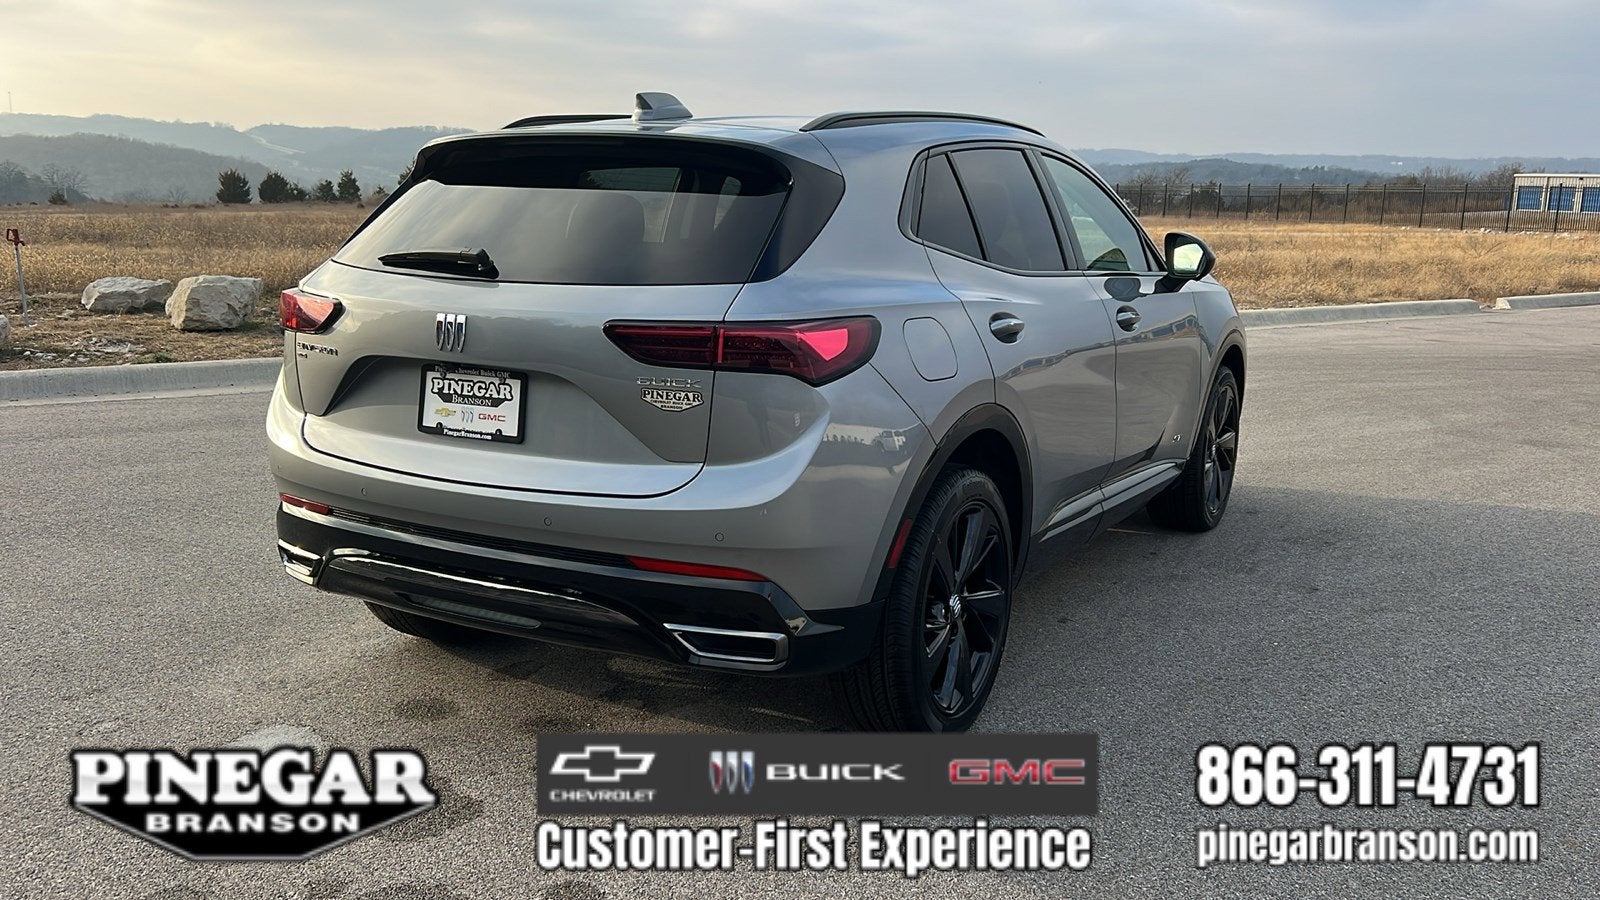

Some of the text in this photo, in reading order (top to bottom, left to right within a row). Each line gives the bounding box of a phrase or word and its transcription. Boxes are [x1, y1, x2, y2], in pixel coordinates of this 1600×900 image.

[636, 376, 702, 388] BUICK
[432, 379, 513, 400] PINEGAR
[642, 389, 702, 403] PINEGAR
[478, 413, 506, 423] GMC
